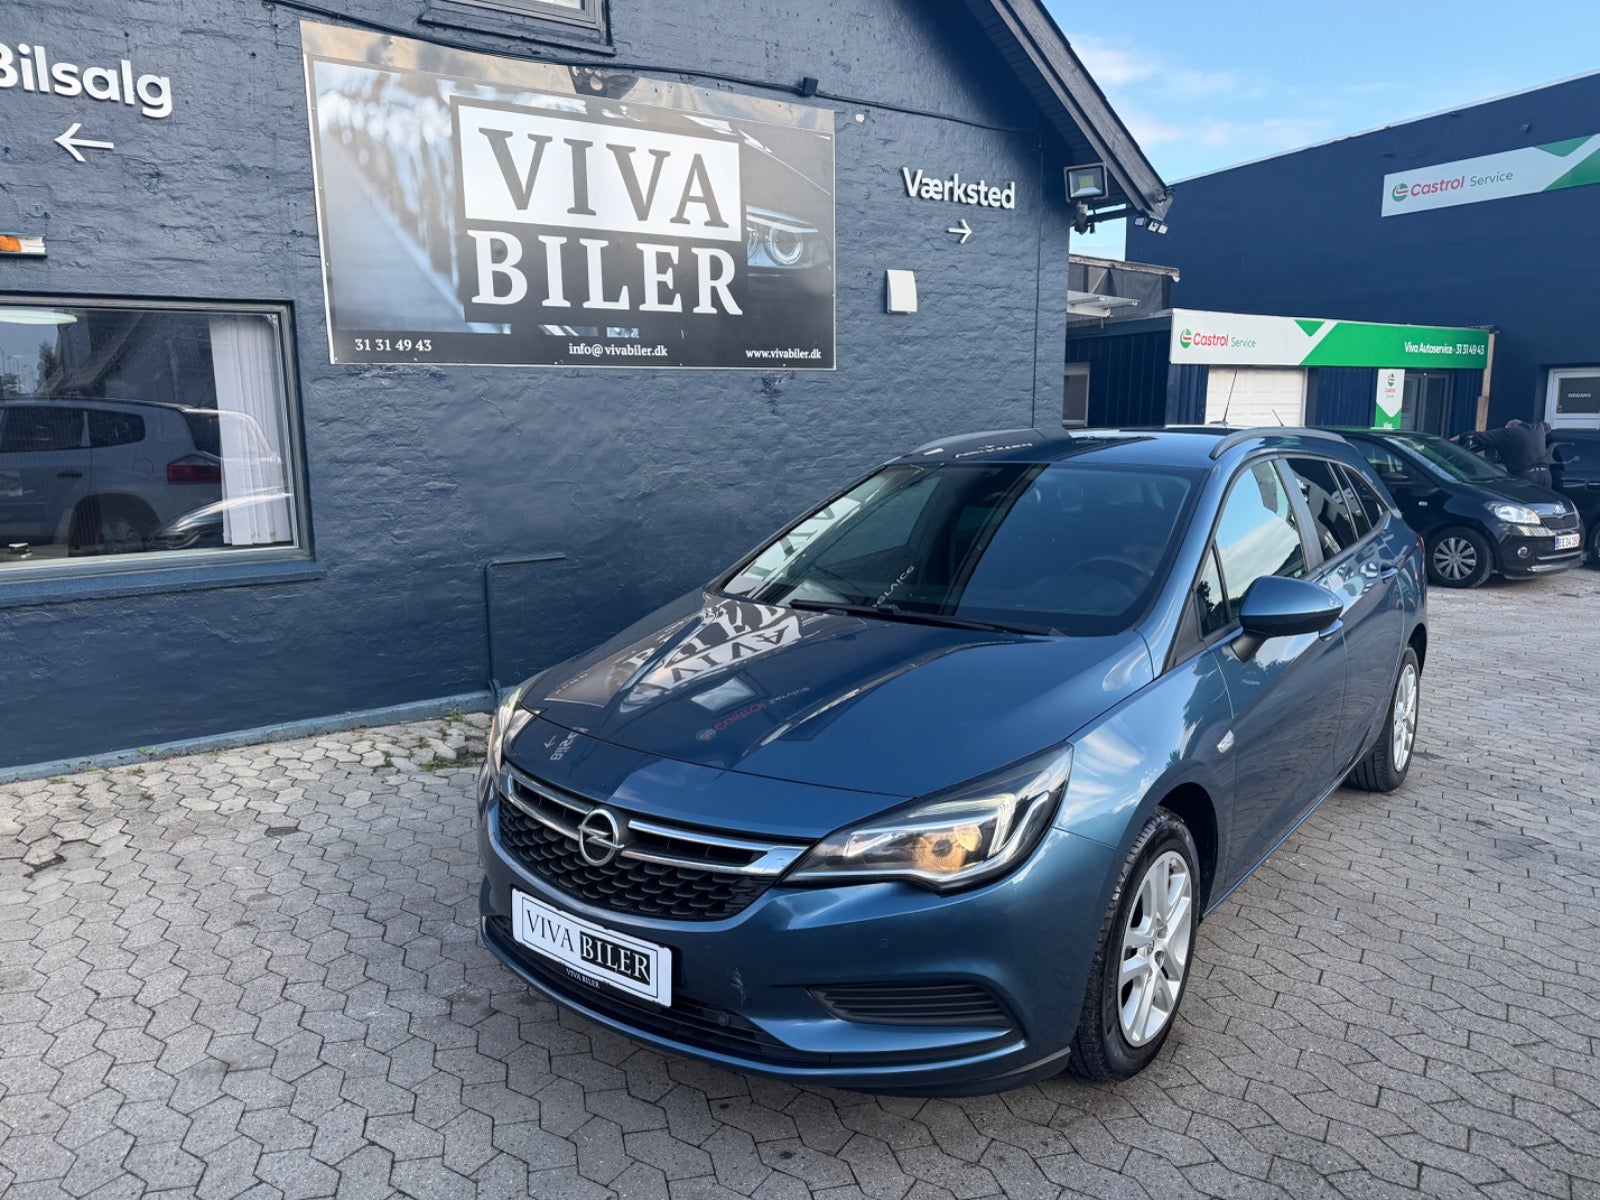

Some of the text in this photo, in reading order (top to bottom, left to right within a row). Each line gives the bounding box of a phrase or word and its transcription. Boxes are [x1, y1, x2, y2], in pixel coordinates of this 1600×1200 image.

[0, 42, 173, 119] Bilsalg
[478, 127, 729, 228] VIVA
[902, 166, 1016, 209] Værksted
[1410, 171, 1514, 197] Castrol Service
[466, 229, 743, 316] BILER
[354, 338, 432, 352] 31 31 49 43
[1193, 332, 1256, 348] Castrol Service
[1404, 341, 1419, 353] Viva
[1419, 342, 1453, 354] Autoservice
[745, 348, 822, 359] www.vivabiler.dk
[526, 909, 650, 981] VIVA BILER
[566, 968, 582, 981] VIVA
